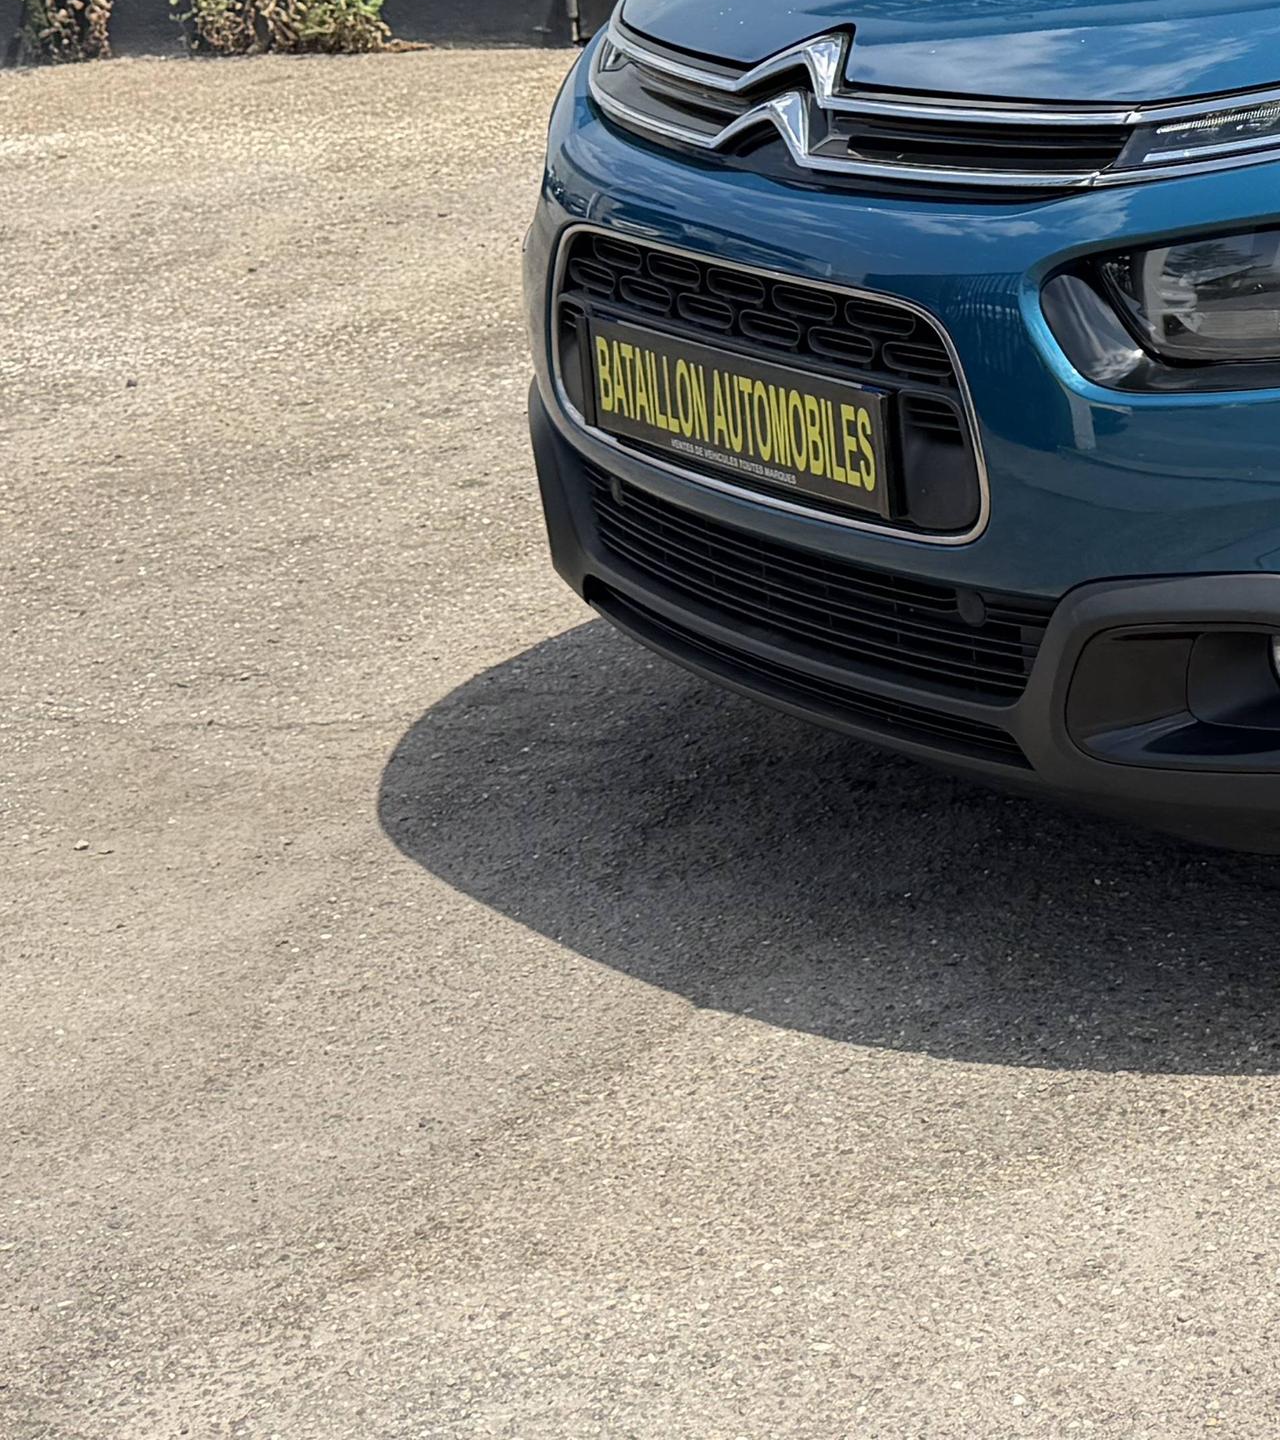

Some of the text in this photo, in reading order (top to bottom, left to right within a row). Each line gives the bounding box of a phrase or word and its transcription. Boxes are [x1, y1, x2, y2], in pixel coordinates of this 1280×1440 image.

[596, 335, 876, 492] BATAILLON AUTOMOBILES
[695, 446, 704, 457] DE
[764, 467, 797, 485] MARQUES
